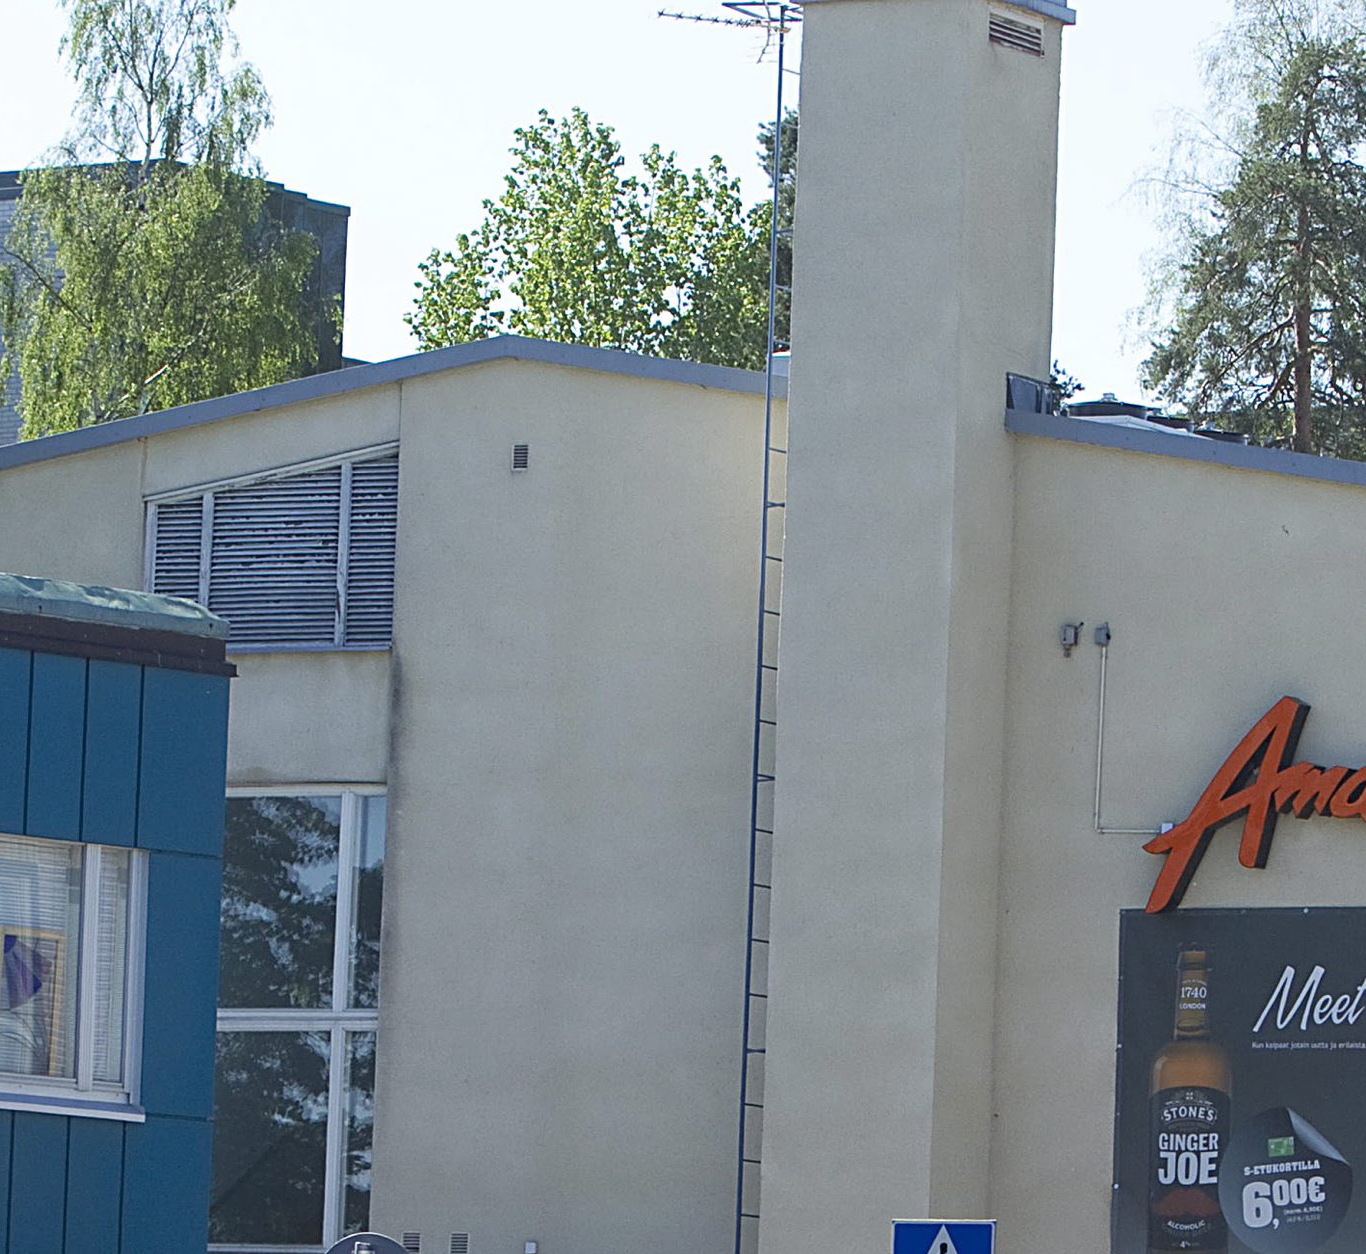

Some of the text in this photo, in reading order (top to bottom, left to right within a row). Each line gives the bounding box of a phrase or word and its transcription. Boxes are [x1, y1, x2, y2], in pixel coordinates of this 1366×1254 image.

[1181, 986, 1207, 999] 1740
[1179, 1002, 1206, 1010] LONDON
[1163, 1105, 1215, 1122] STONE'S
[1158, 1132, 1219, 1151] GINGER
[1158, 1151, 1219, 1185] JOE
[1243, 1160, 1321, 1176] S-ETUKORTILLA
